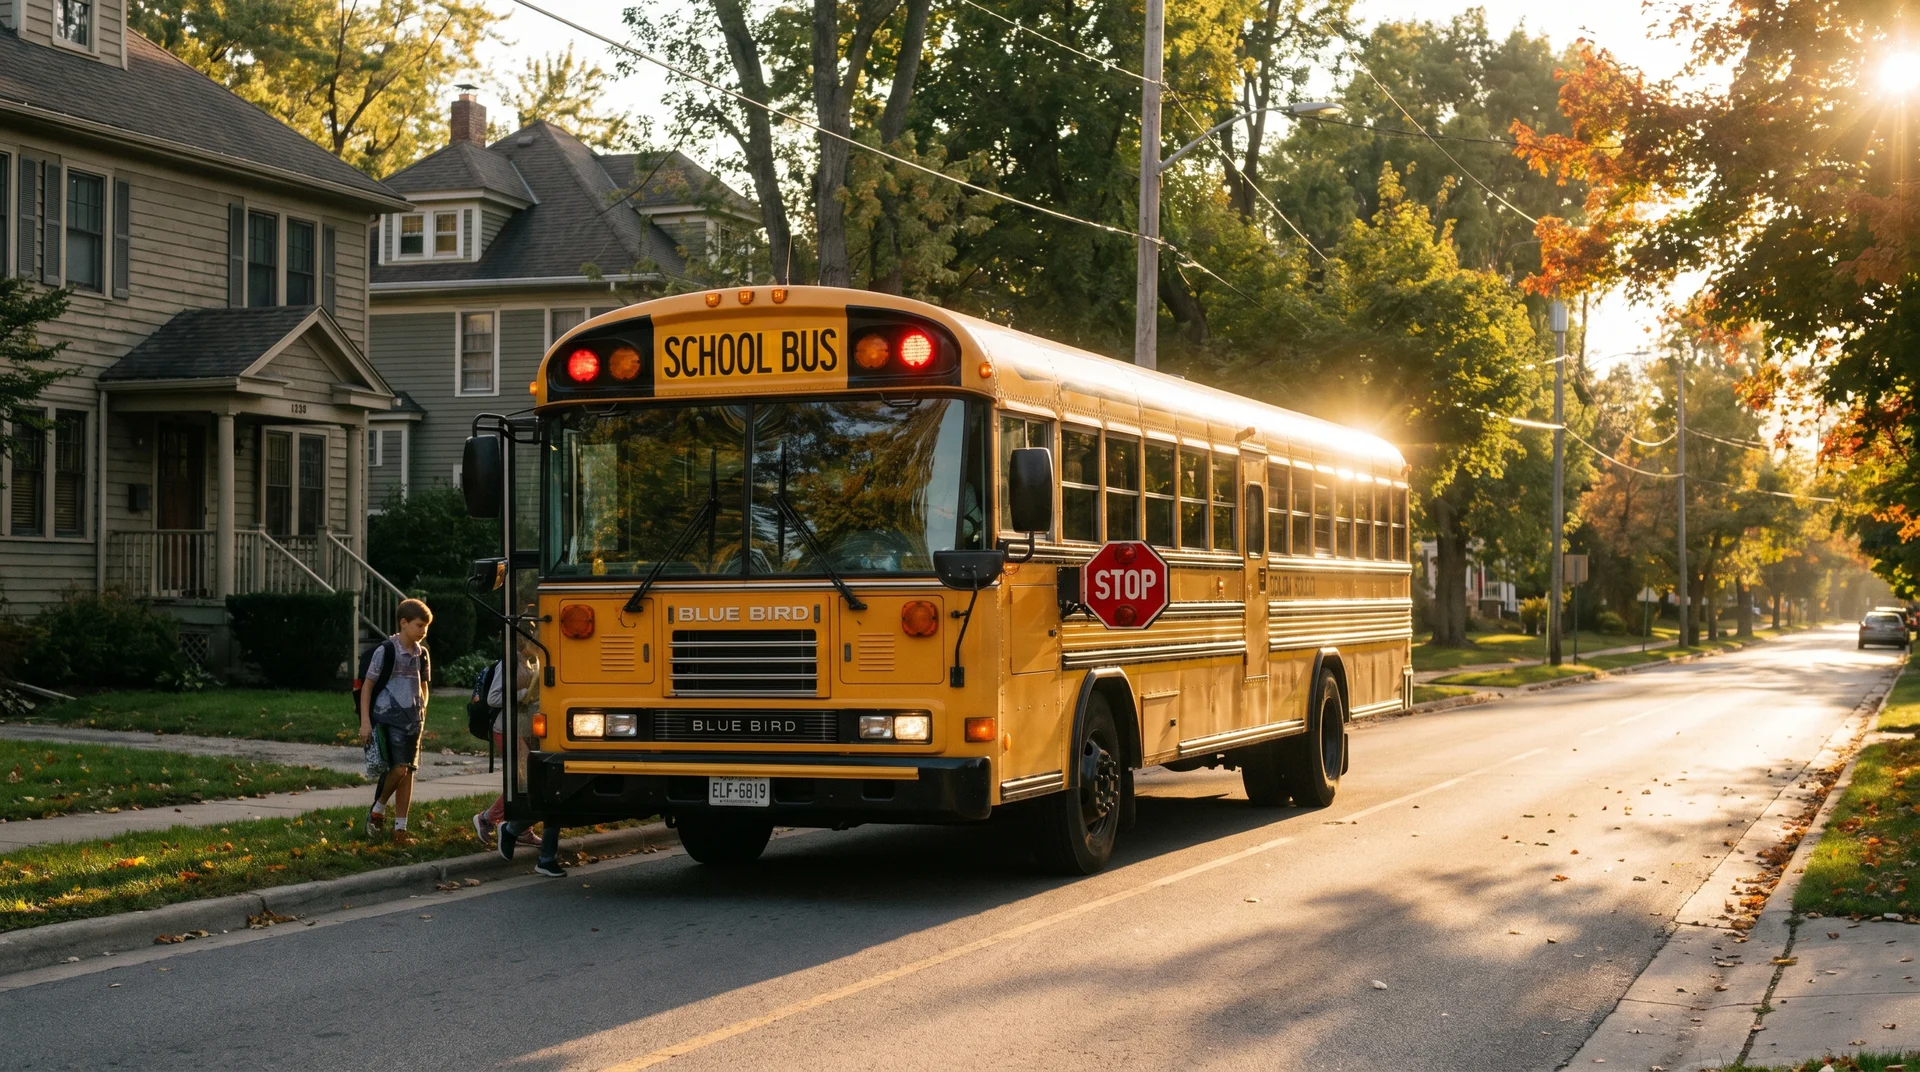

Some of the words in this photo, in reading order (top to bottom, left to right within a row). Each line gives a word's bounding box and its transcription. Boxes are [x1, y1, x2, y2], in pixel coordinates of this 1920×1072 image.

[664, 332, 772, 378] SCHOOL
[782, 328, 838, 373] BUS
[1095, 569, 1157, 600] STOP
[678, 606, 740, 621] BLUE
[749, 606, 809, 621] BIRD
[692, 720, 742, 731] BLUE
[750, 720, 796, 732] BIRD
